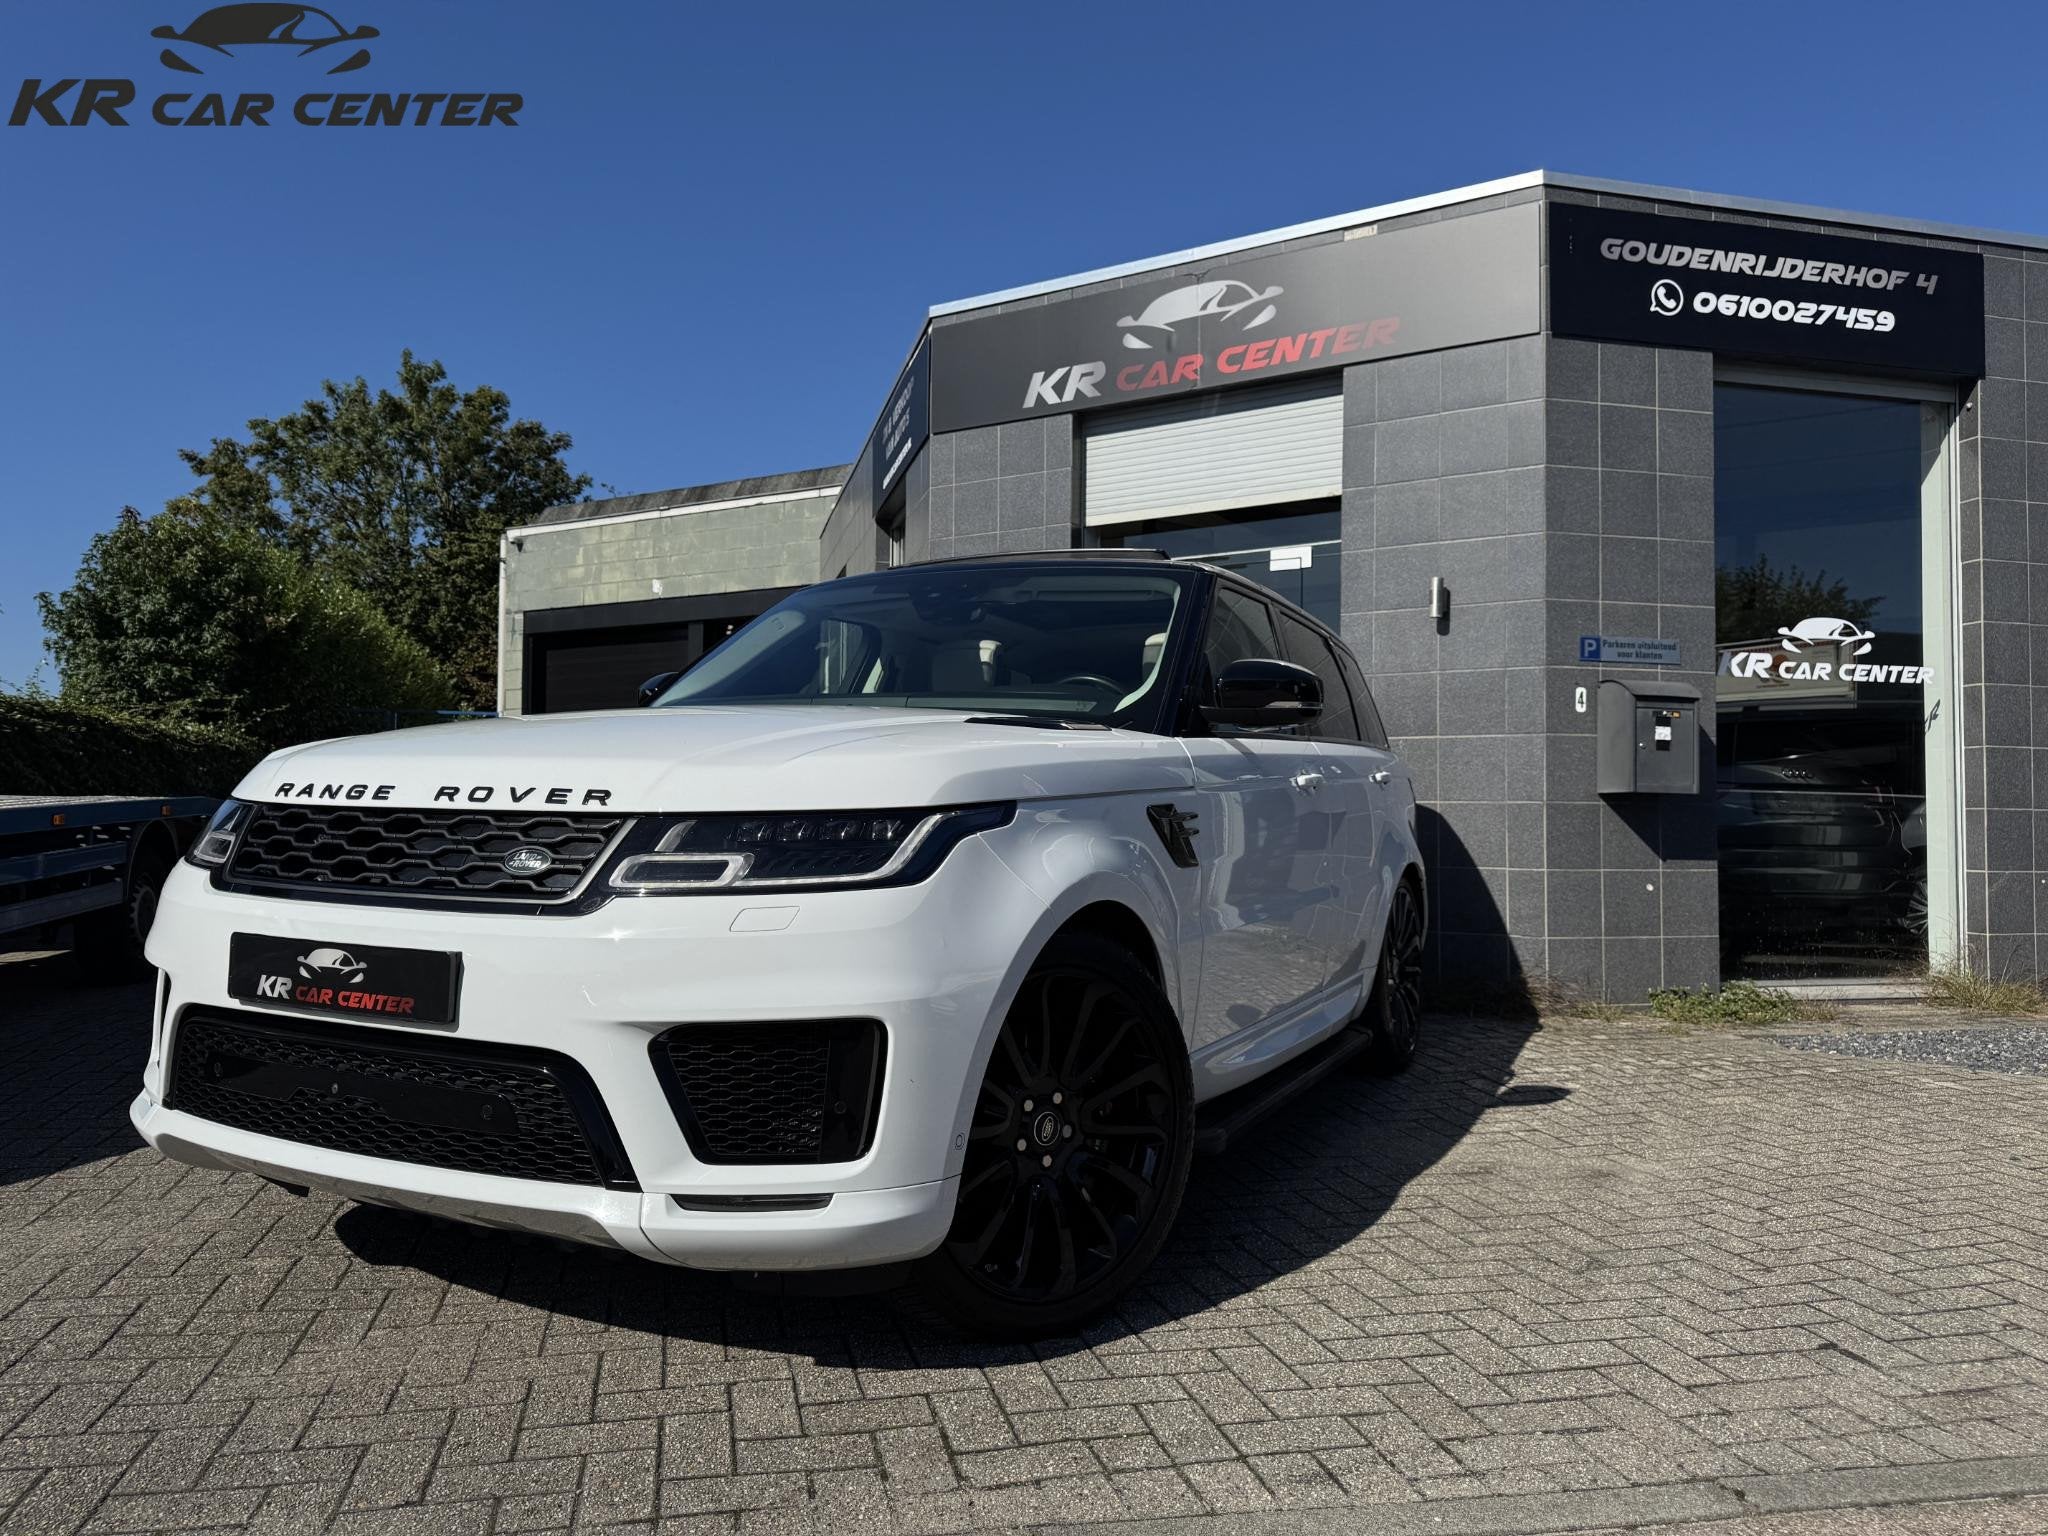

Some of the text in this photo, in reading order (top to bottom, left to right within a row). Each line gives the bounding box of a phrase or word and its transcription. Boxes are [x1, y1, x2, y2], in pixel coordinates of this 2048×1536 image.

[1600, 237, 1939, 295] GOUDENRIJDERHOF 4
[1693, 291, 1896, 333] 0610027459
[1022, 316, 1402, 409] KR CAR CENTER
[1584, 638, 1597, 657] P
[1602, 639, 1677, 651] Parkeren uitsluitend
[1635, 650, 1663, 660] klanten
[1718, 652, 1936, 685] KR CAR CENTER
[1577, 691, 1585, 708] 4
[275, 782, 613, 807] RANGE ROVER
[256, 974, 415, 1014] KR CAR CENTER
